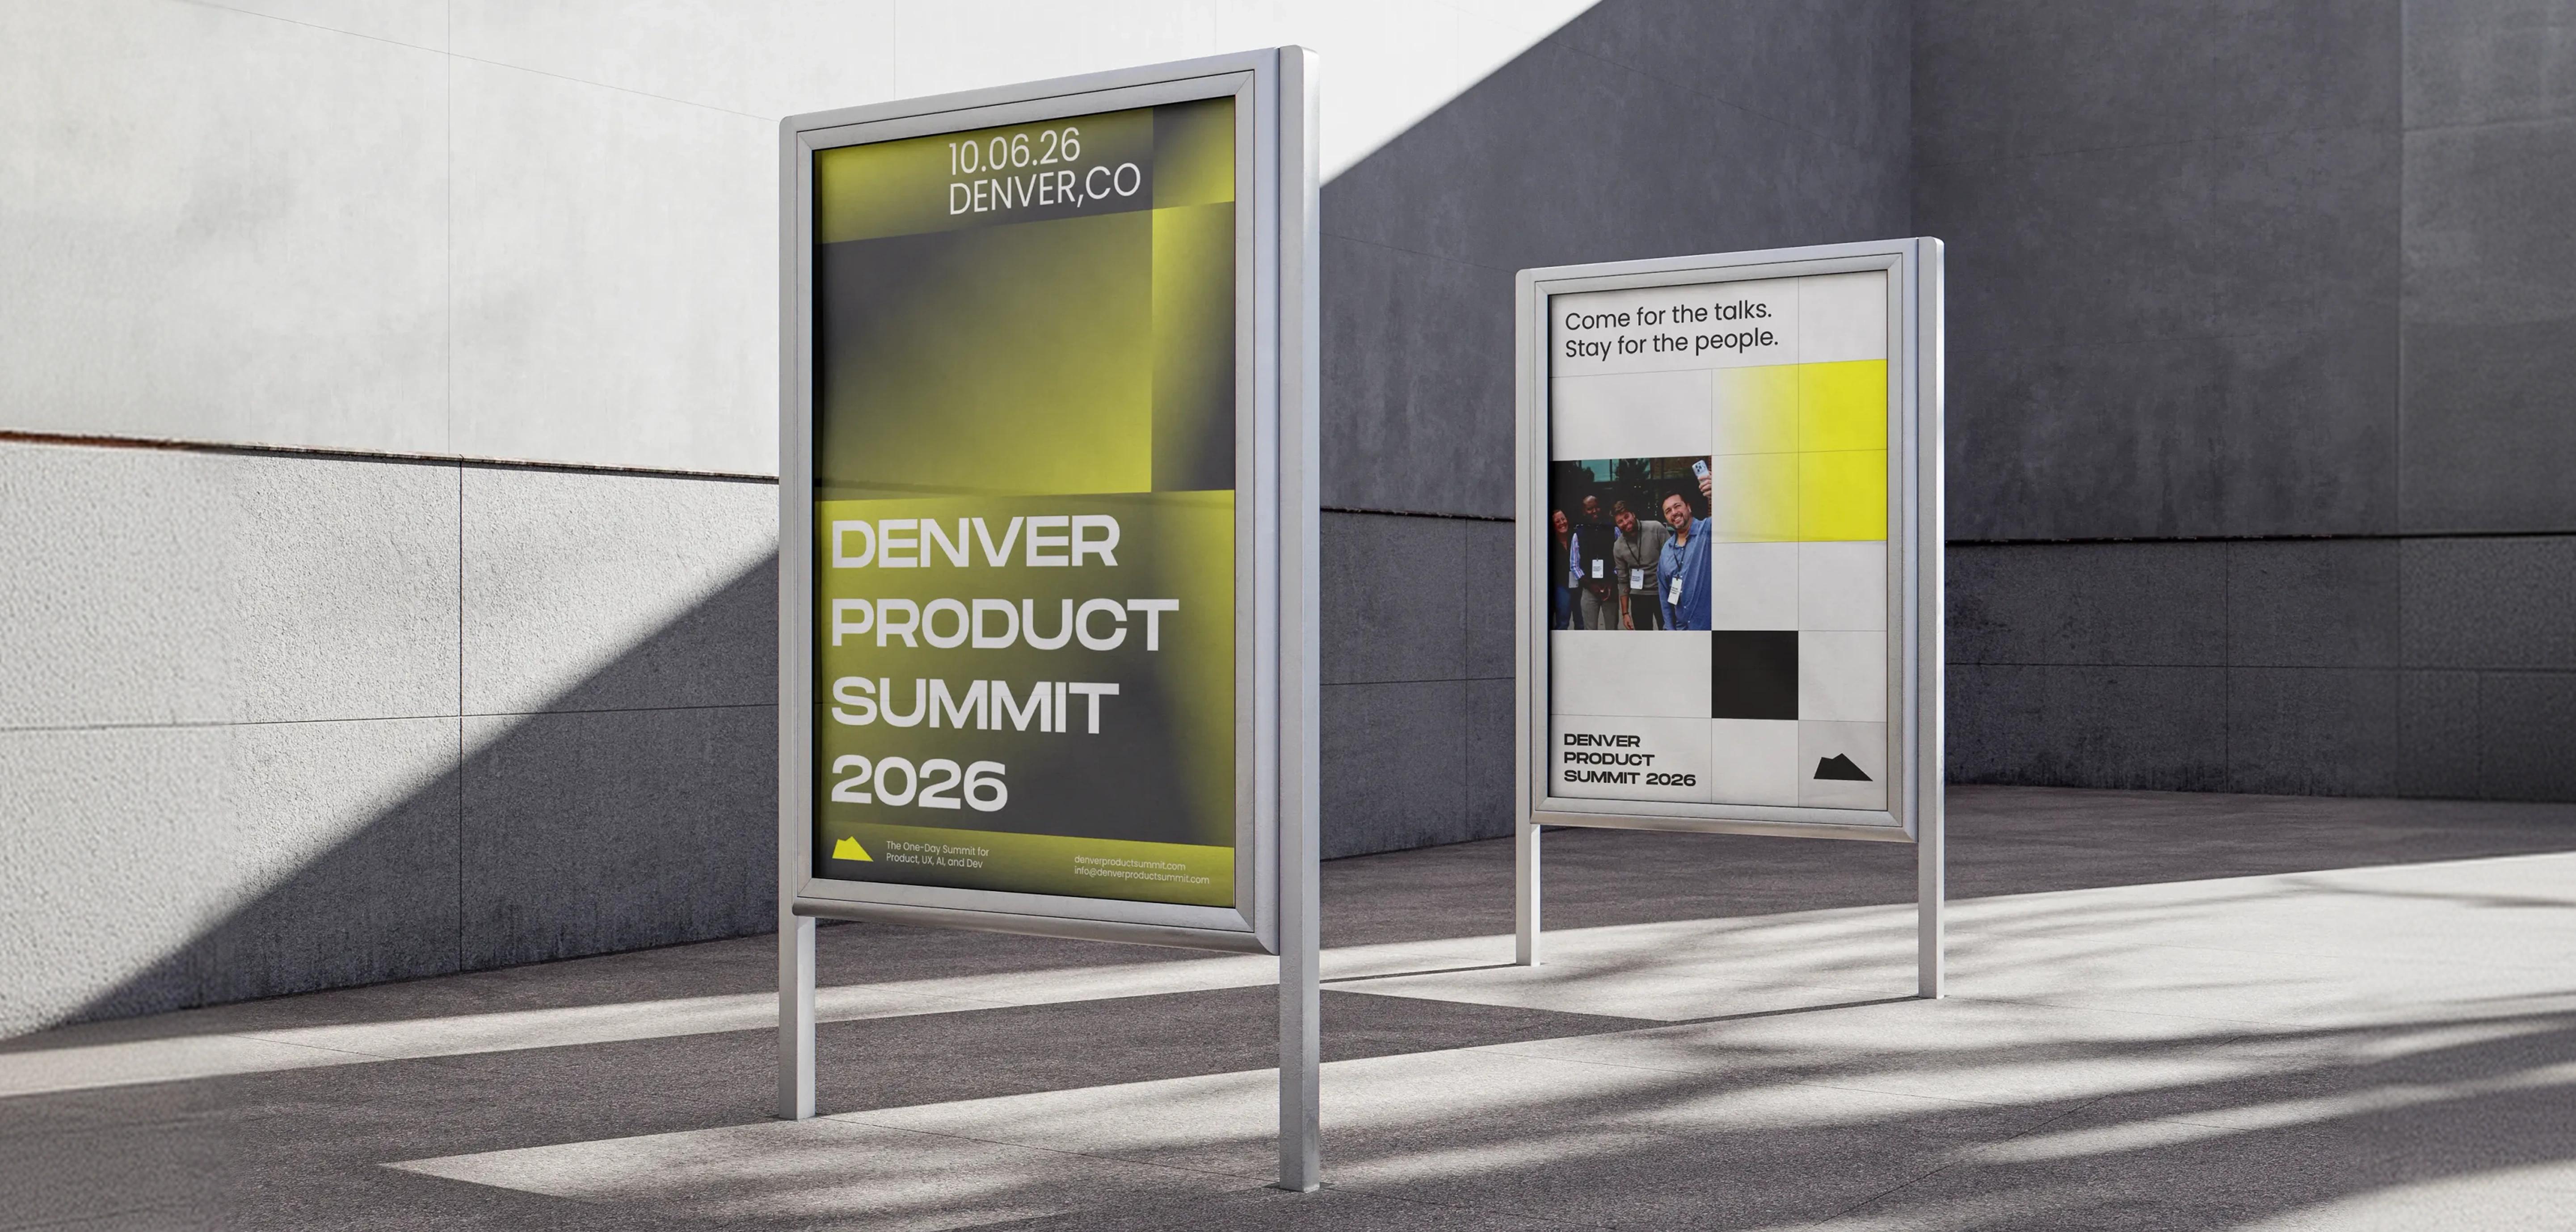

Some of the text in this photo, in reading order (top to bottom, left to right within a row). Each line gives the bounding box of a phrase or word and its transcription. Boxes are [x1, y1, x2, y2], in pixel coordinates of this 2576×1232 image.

[949, 127, 1081, 175] 10.06.26
[950, 162, 1141, 215] DENVER,CO
[1565, 300, 1772, 330] Come for the talks.
[1566, 327, 1778, 361] Stay for the people.
[832, 515, 1120, 568] DENVER
[832, 598, 1179, 651] PRODUCT
[832, 676, 1120, 734] SUMMIT
[1564, 733, 1641, 747] DENVER
[1564, 751, 1655, 767] PRODUCT
[831, 755, 1008, 812] 2026
[1564, 770, 1696, 787] SUMMIT 2026
[886, 840, 989, 856] The One-Day Summit for
[886, 853, 983, 868] Product, UX, AI, and Dev
[1074, 855, 1186, 871] denverproductsummit.com
[1074, 866, 1209, 884] info@denverproductsummit.com
